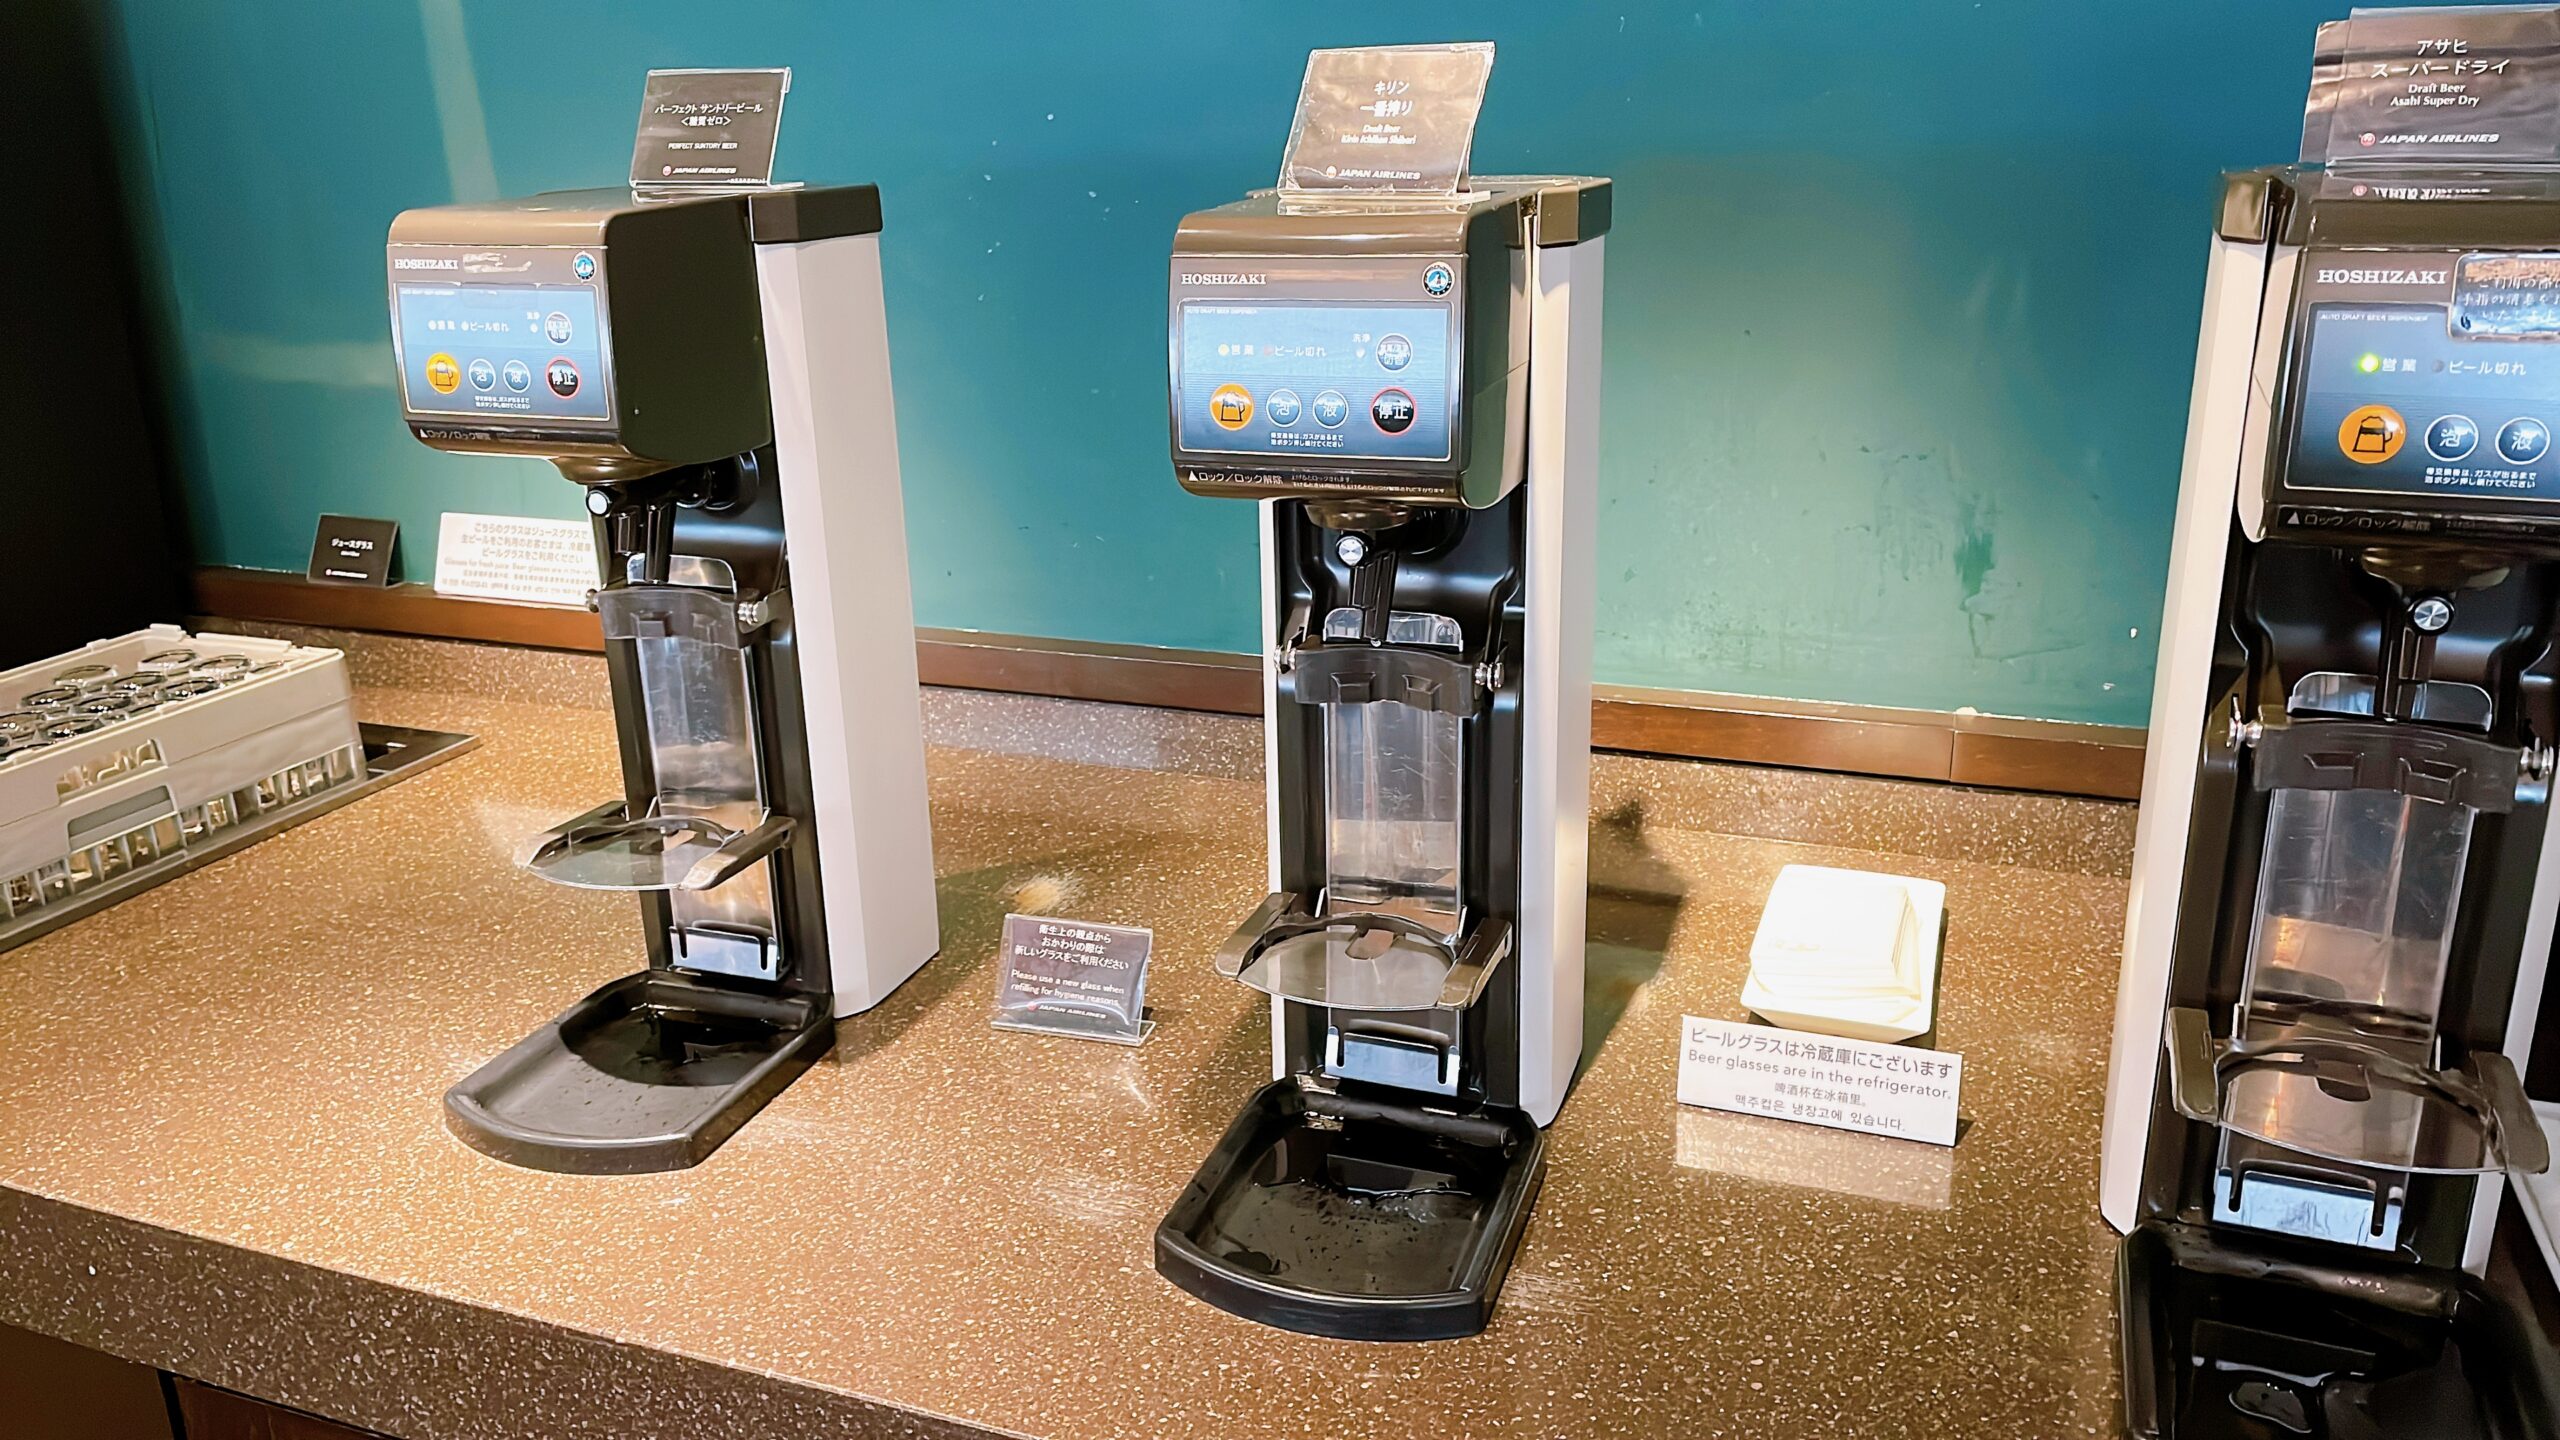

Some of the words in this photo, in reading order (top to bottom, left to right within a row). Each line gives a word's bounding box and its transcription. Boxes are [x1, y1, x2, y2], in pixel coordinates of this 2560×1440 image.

[2416, 38, 2469, 55] アサヒ
[2370, 58, 2511, 79] スーパードライ
[1374, 80, 1410, 96] キリン
[2408, 83, 2437, 94] Draft
[2440, 83, 2466, 94] Beer
[654, 103, 697, 114] パーフェクト
[700, 102, 763, 114] サントリービール
[1360, 100, 1413, 118] 一番搾り
[2390, 96, 2421, 107] Asahi
[2423, 96, 2456, 108] Super
[2458, 95, 2480, 108] Dry
[1363, 124, 1383, 133] Draft
[1384, 124, 1400, 133] Beer
[668, 142, 693, 150] PERFECT
[694, 142, 720, 150] SUNTORY
[722, 142, 738, 150] BEER
[2379, 134, 2430, 144] JAPAN
[2430, 133, 2500, 144] AIRLINES
[1339, 169, 1371, 178] JAPAN
[1372, 170, 1421, 180] AIRLINES
[394, 258, 458, 270] HOSHIZAKI
[1181, 273, 1267, 285] HOSHIZAKI
[2317, 269, 2448, 285] HOSHIZAKI
[1274, 346, 1327, 357] ビール切れ
[2382, 358, 2417, 372] 営業
[2450, 360, 2527, 376] ビール切れ
[1277, 403, 1290, 416] 泡
[1323, 403, 1338, 418] 液
[1378, 403, 1409, 420] 停止
[2440, 427, 2461, 448] 泡
[2512, 428, 2533, 451] 液
[331, 538, 374, 550] ジュースグラス
[1039, 924, 1112, 944] 衛生上の観点から
[1042, 937, 1105, 954] おかわりの際は
[1015, 945, 1129, 970] 新しいグラスをご利用ください
[1011, 969, 1037, 982] Please
[1039, 975, 1053, 984] use
[1055, 977, 1061, 985] a
[1062, 979, 1079, 987] new
[1080, 980, 1101, 991] glass
[1103, 984, 1124, 994] when
[1011, 982, 1040, 996] refilling
[1041, 986, 1053, 996] for
[1054, 988, 1085, 1002] hygiene
[1038, 1004, 1066, 1013] JAPAN
[1067, 1008, 1107, 1019] AIRLINES
[1692, 1028, 1953, 1079] ビールグラスは冷蔵庫にございます
[1689, 1049, 1722, 1065] Beer
[1726, 1054, 1780, 1075] glasses
[1783, 1066, 1807, 1078] are
[1811, 1067, 1824, 1080] in
[1828, 1070, 1854, 1085] the
[1857, 1075, 1953, 1100] refrigerator.
[1774, 1082, 1867, 1107] 啤酒杯在冰箱里。
[1735, 1093, 1785, 1113] 맥주컵은
[1791, 1101, 1843, 1122] 냉장고에
[1850, 1111, 1906, 1132] 있습니다.
